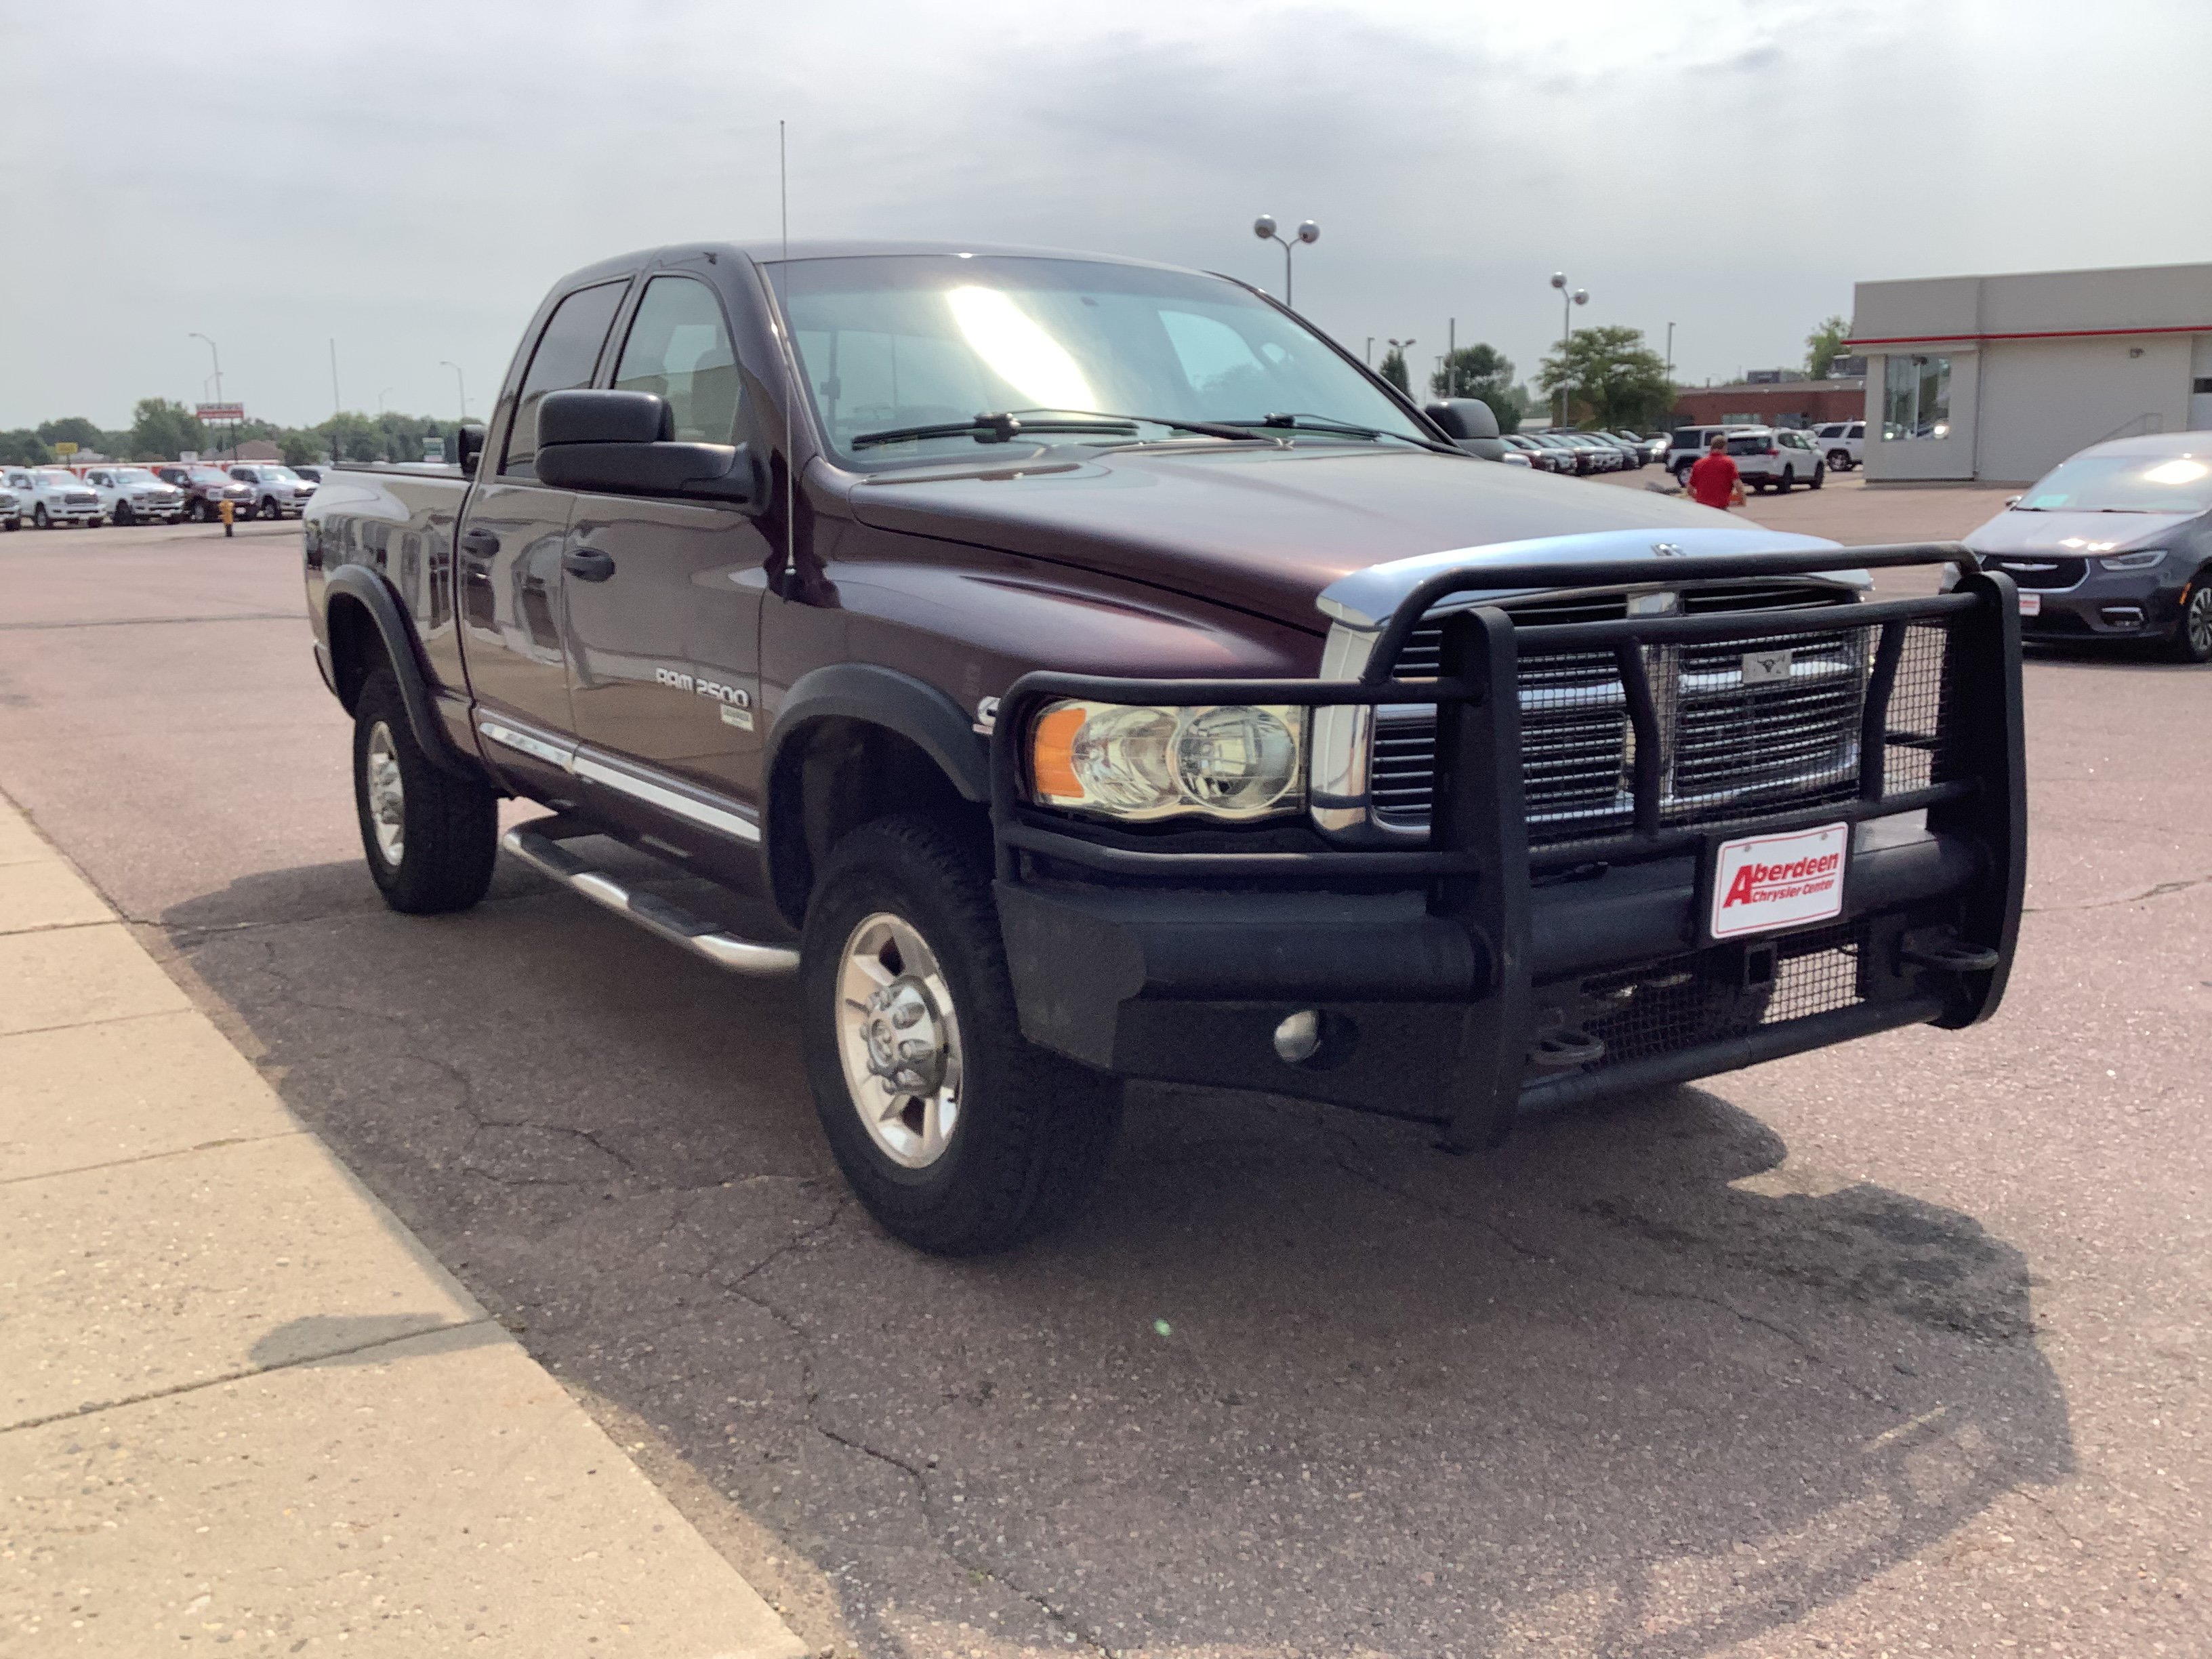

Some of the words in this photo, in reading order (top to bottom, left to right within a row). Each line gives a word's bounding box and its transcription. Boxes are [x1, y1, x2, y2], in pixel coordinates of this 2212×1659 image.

[656, 668, 693, 691] RAM
[696, 678, 749, 707] 2500
[1723, 853, 1839, 908] Aberdeen
[1753, 887, 1801, 903] Chrysler
[1802, 880, 1834, 895] Center
